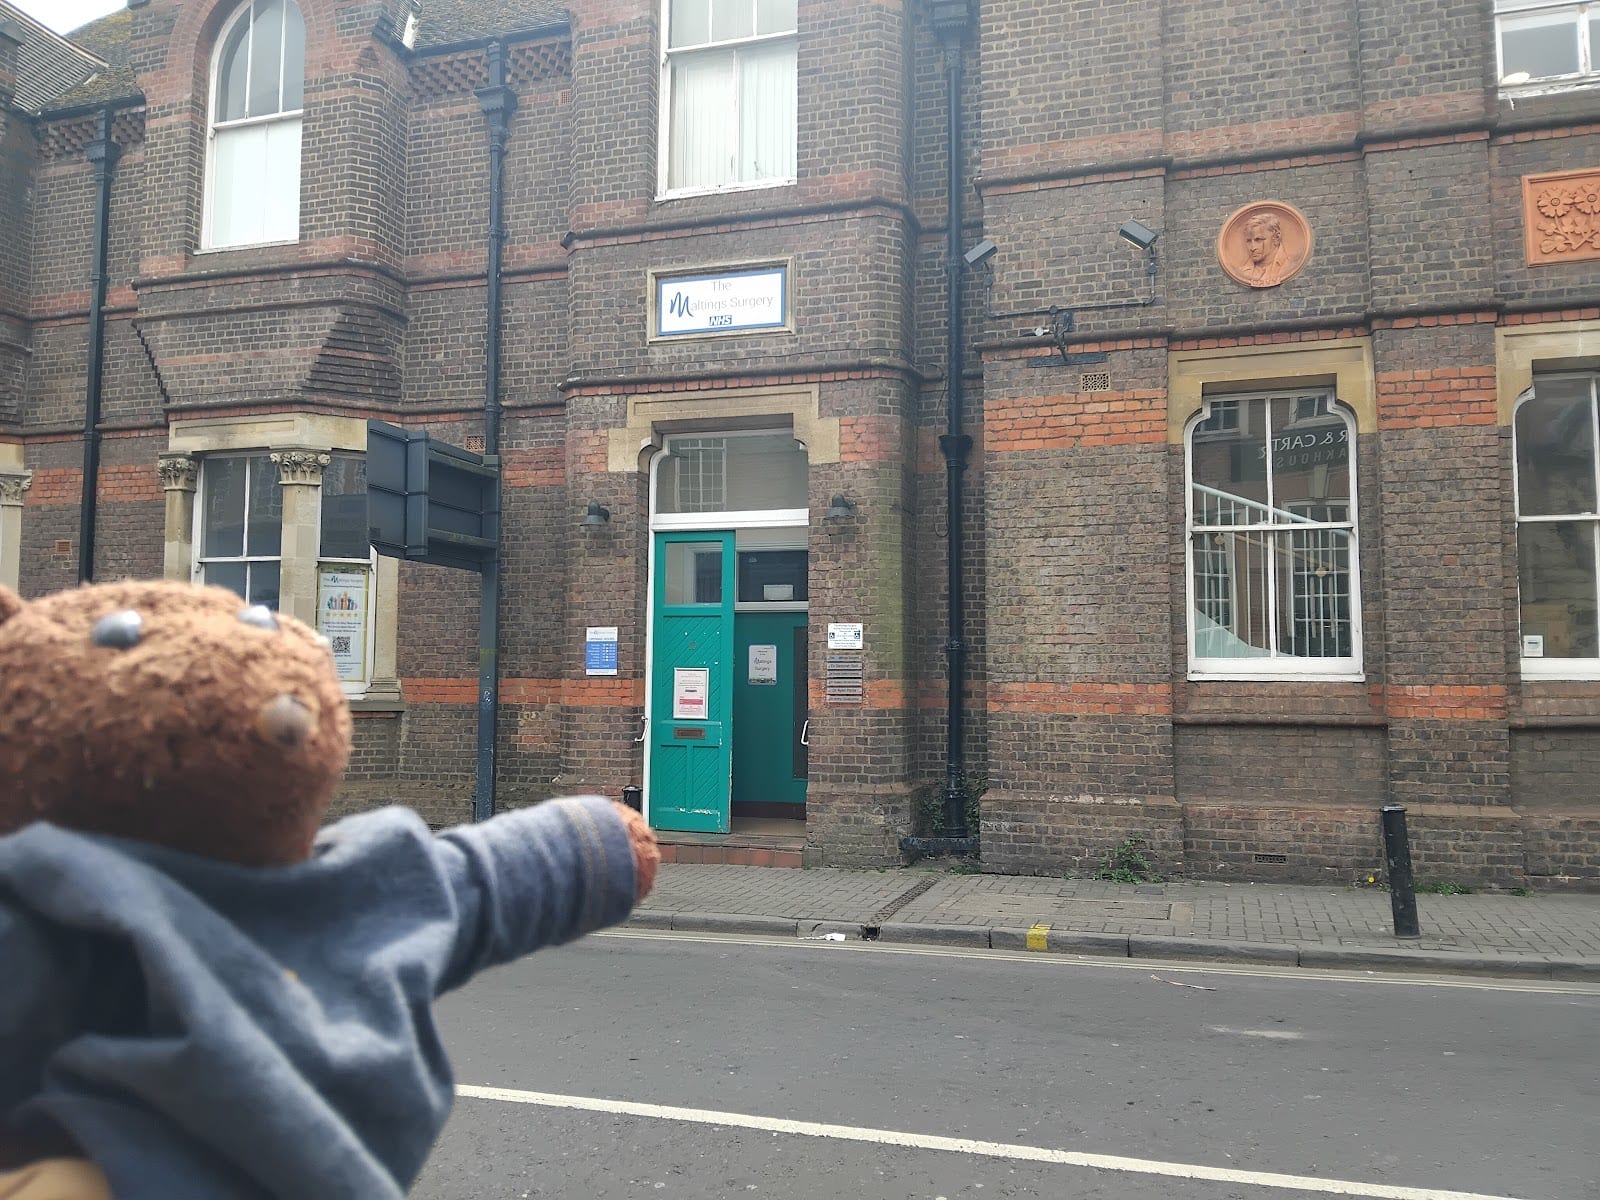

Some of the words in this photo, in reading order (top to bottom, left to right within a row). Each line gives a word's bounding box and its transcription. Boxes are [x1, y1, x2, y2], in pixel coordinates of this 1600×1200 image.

[711, 280, 732, 292] The
[669, 291, 727, 317] Maltings
[730, 294, 775, 309] Surgery
[709, 315, 732, 326] NHS
